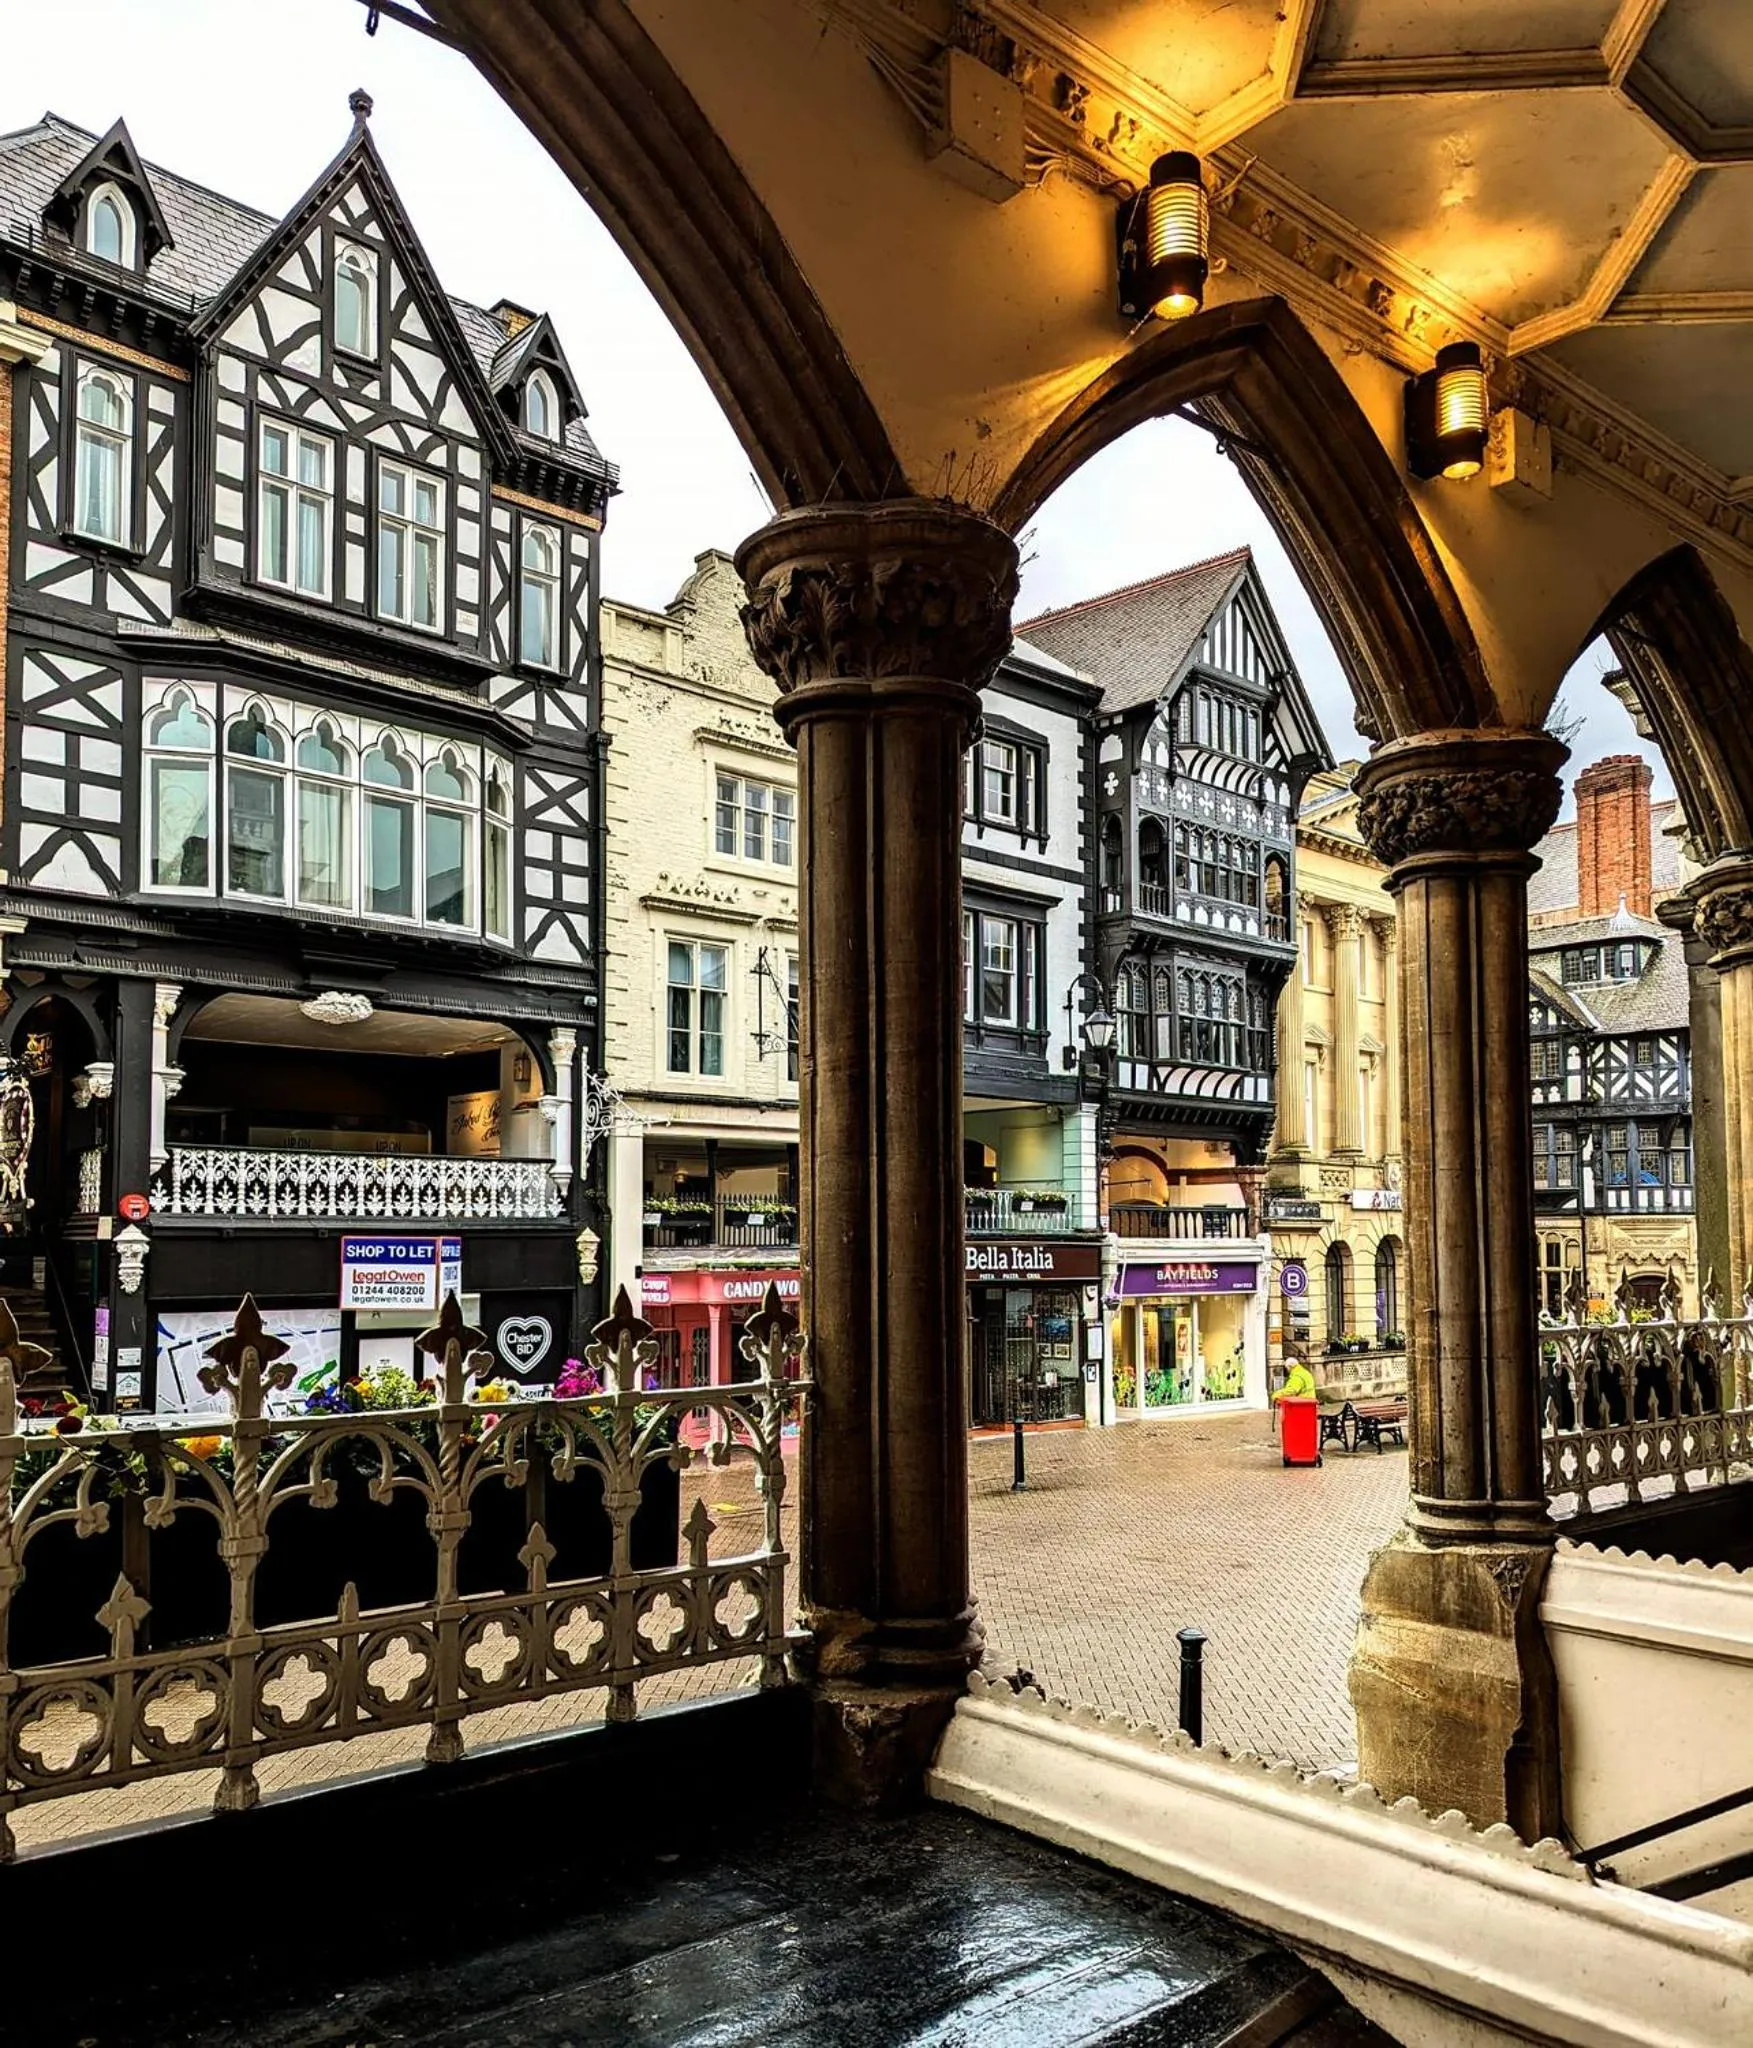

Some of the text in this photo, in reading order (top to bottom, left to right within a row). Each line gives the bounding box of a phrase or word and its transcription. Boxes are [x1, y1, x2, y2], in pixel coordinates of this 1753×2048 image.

[346, 1245, 385, 1258] SHOP
[388, 1245, 406, 1259] TO
[409, 1246, 434, 1259] LET
[965, 1246, 1054, 1270] Bella Italia
[1157, 1269, 1219, 1280] BAYFIELDS
[1286, 1273, 1300, 1288] B
[352, 1286, 425, 1295] 01244 408200
[776, 1279, 800, 1296] WO
[507, 1332, 543, 1344] Chester
[516, 1344, 534, 1355] BID
